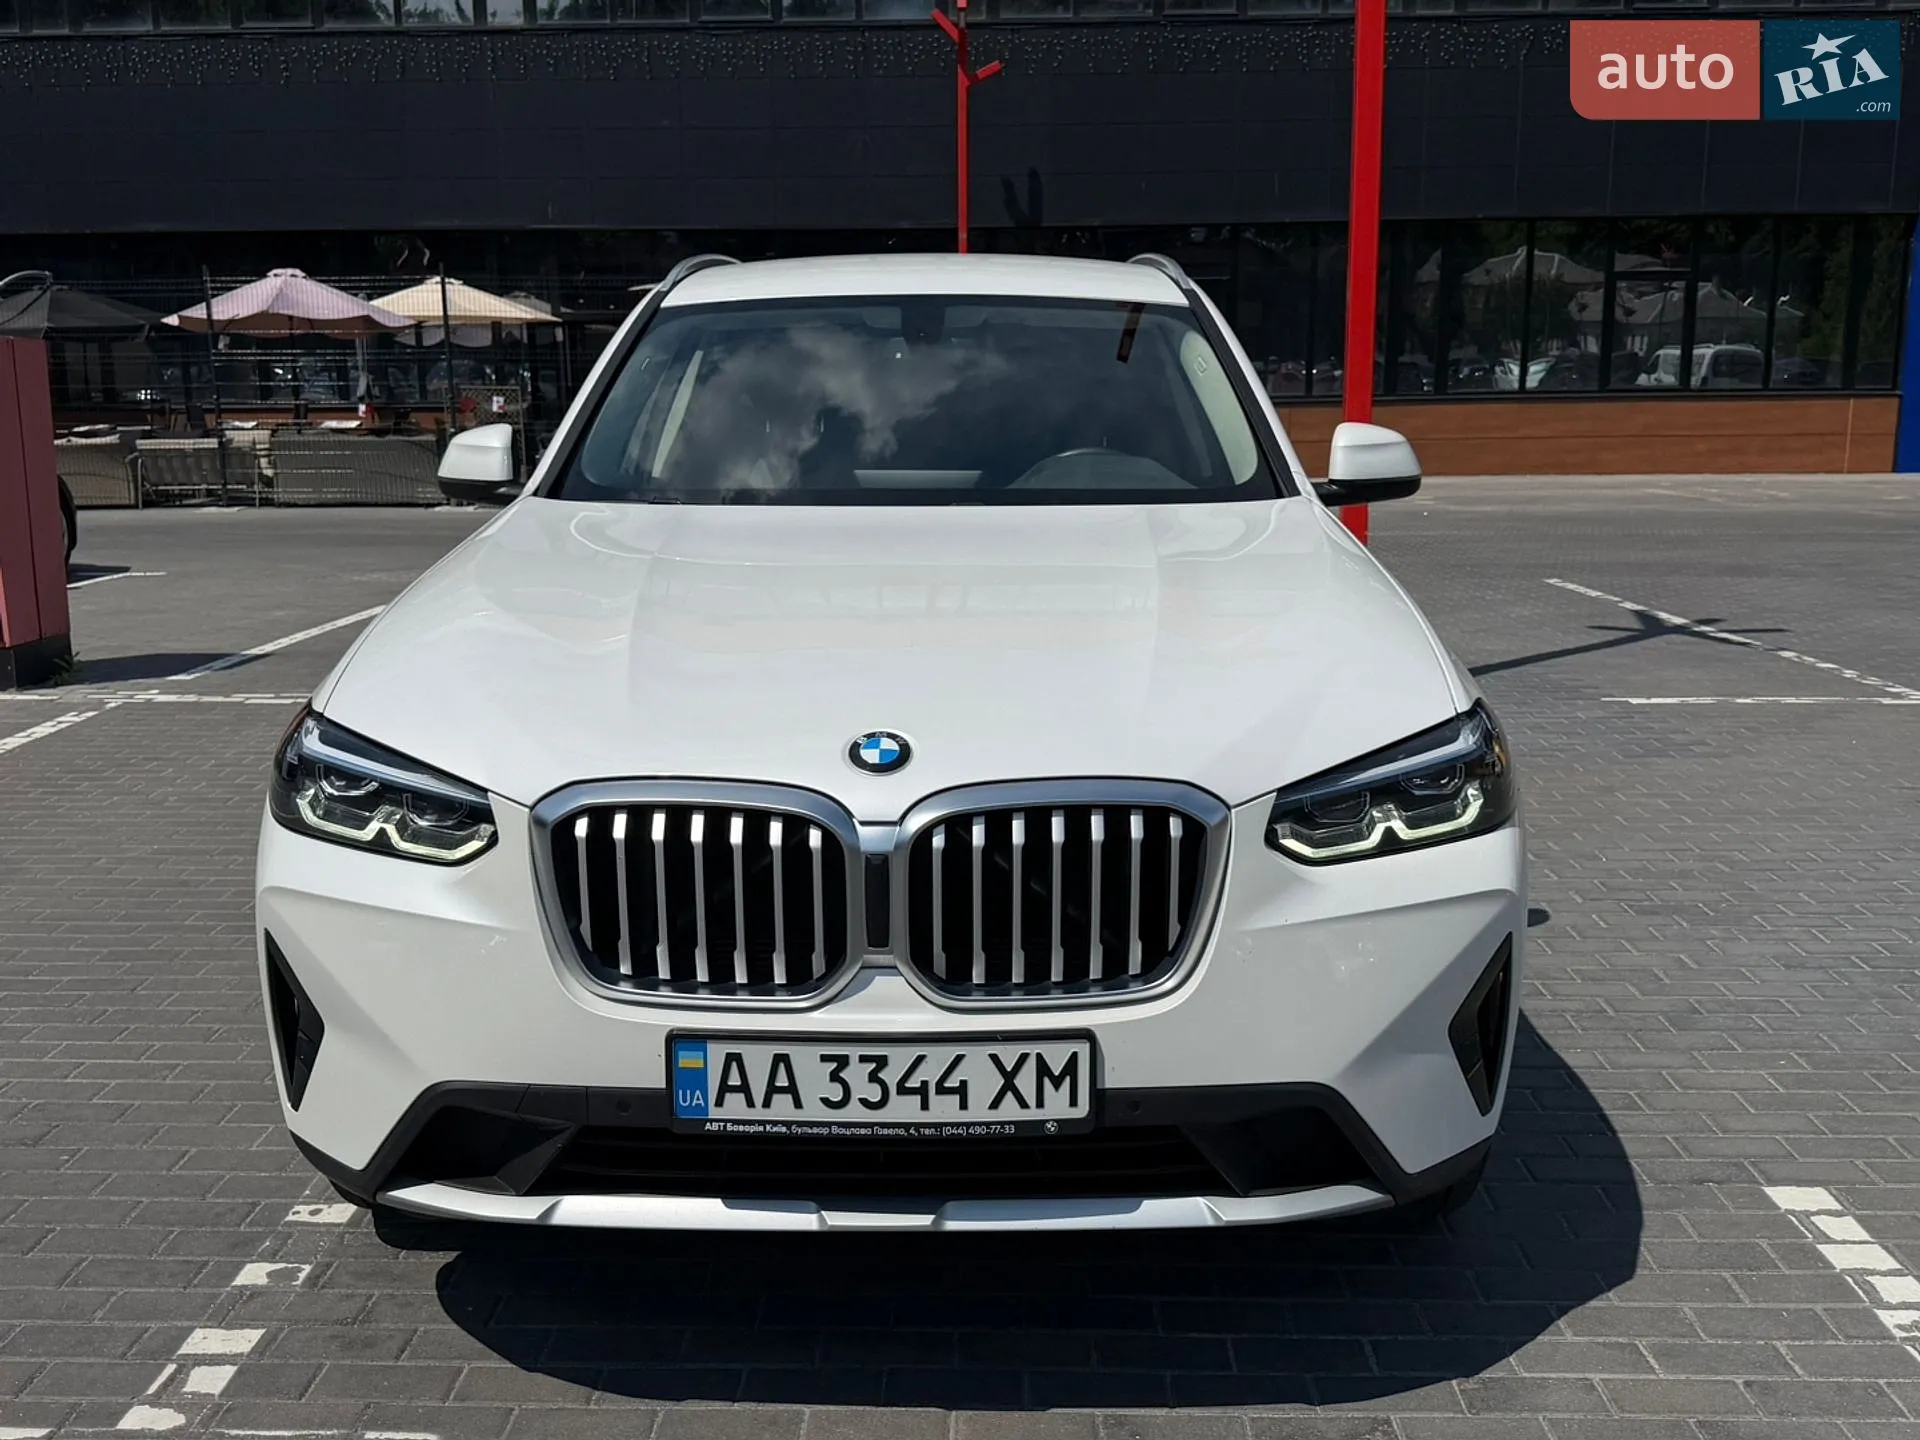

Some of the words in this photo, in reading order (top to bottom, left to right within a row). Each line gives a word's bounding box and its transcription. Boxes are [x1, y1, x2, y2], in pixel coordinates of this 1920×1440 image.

[714, 1052, 803, 1109] AA
[819, 1053, 968, 1111] 3344
[987, 1051, 1079, 1110] XM
[678, 1089, 705, 1107] UA
[942, 1126, 967, 1136] (044)
[968, 1124, 1015, 1134] 490-77-33
